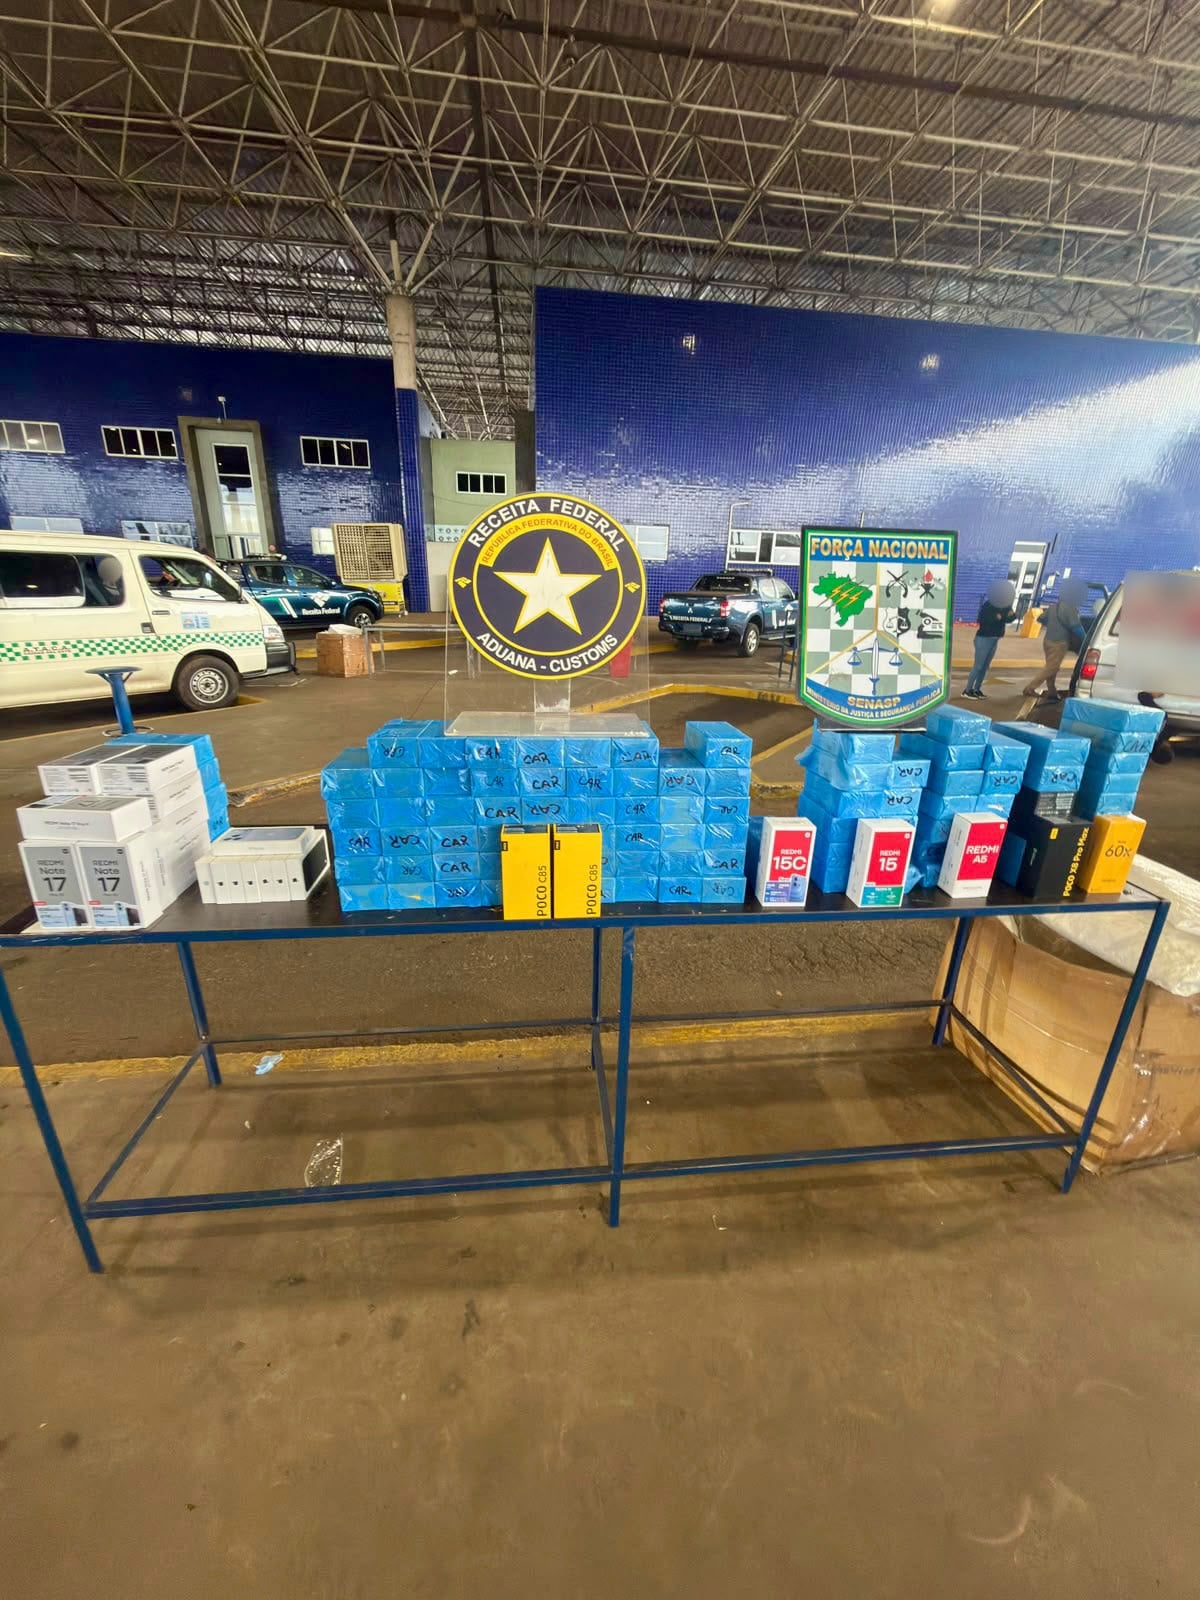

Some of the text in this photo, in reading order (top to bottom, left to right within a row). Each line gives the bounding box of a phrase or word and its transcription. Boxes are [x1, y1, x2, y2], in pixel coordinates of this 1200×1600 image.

[468, 498, 625, 552] RECEITA FEDERAL
[522, 518, 577, 531] FEDERATIVA
[578, 527, 592, 539] DO
[591, 538, 613, 567] BRASIL
[811, 537, 947, 560] FORÇA NACIONAL
[476, 632, 537, 671] ADUANA
[549, 634, 618, 672] CUSTOMS
[847, 696, 901, 709] SENASP
[721, 746, 740, 756] CAR
[523, 752, 551, 764] CAR
[898, 766, 923, 778] CAR
[532, 775, 562, 790] CAR
[579, 775, 602, 790] CAR
[665, 775, 695, 788] CAR
[993, 776, 1018, 787] CAR
[886, 795, 913, 806] CAR
[484, 806, 519, 819] CAR
[526, 803, 561, 816] CAR
[625, 803, 646, 815] CAR
[389, 834, 420, 849] CAR
[441, 835, 470, 848] CAR
[625, 833, 644, 842] CAR
[1077, 827, 1090, 846] Max
[966, 845, 1000, 854] REDMI
[1073, 846, 1083, 861] Pro
[1105, 844, 1132, 857] 60x
[773, 856, 807, 870] 15C
[879, 857, 898, 871] 15
[972, 855, 988, 864] A5
[39, 867, 65, 875] Note
[94, 867, 120, 875] Note
[440, 861, 472, 873] CAR
[43, 877, 66, 892] 17
[97, 877, 120, 892] 17
[536, 865, 547, 917] POCO C85
[586, 864, 598, 915] POCO C85
[1062, 874, 1075, 897] POCO
